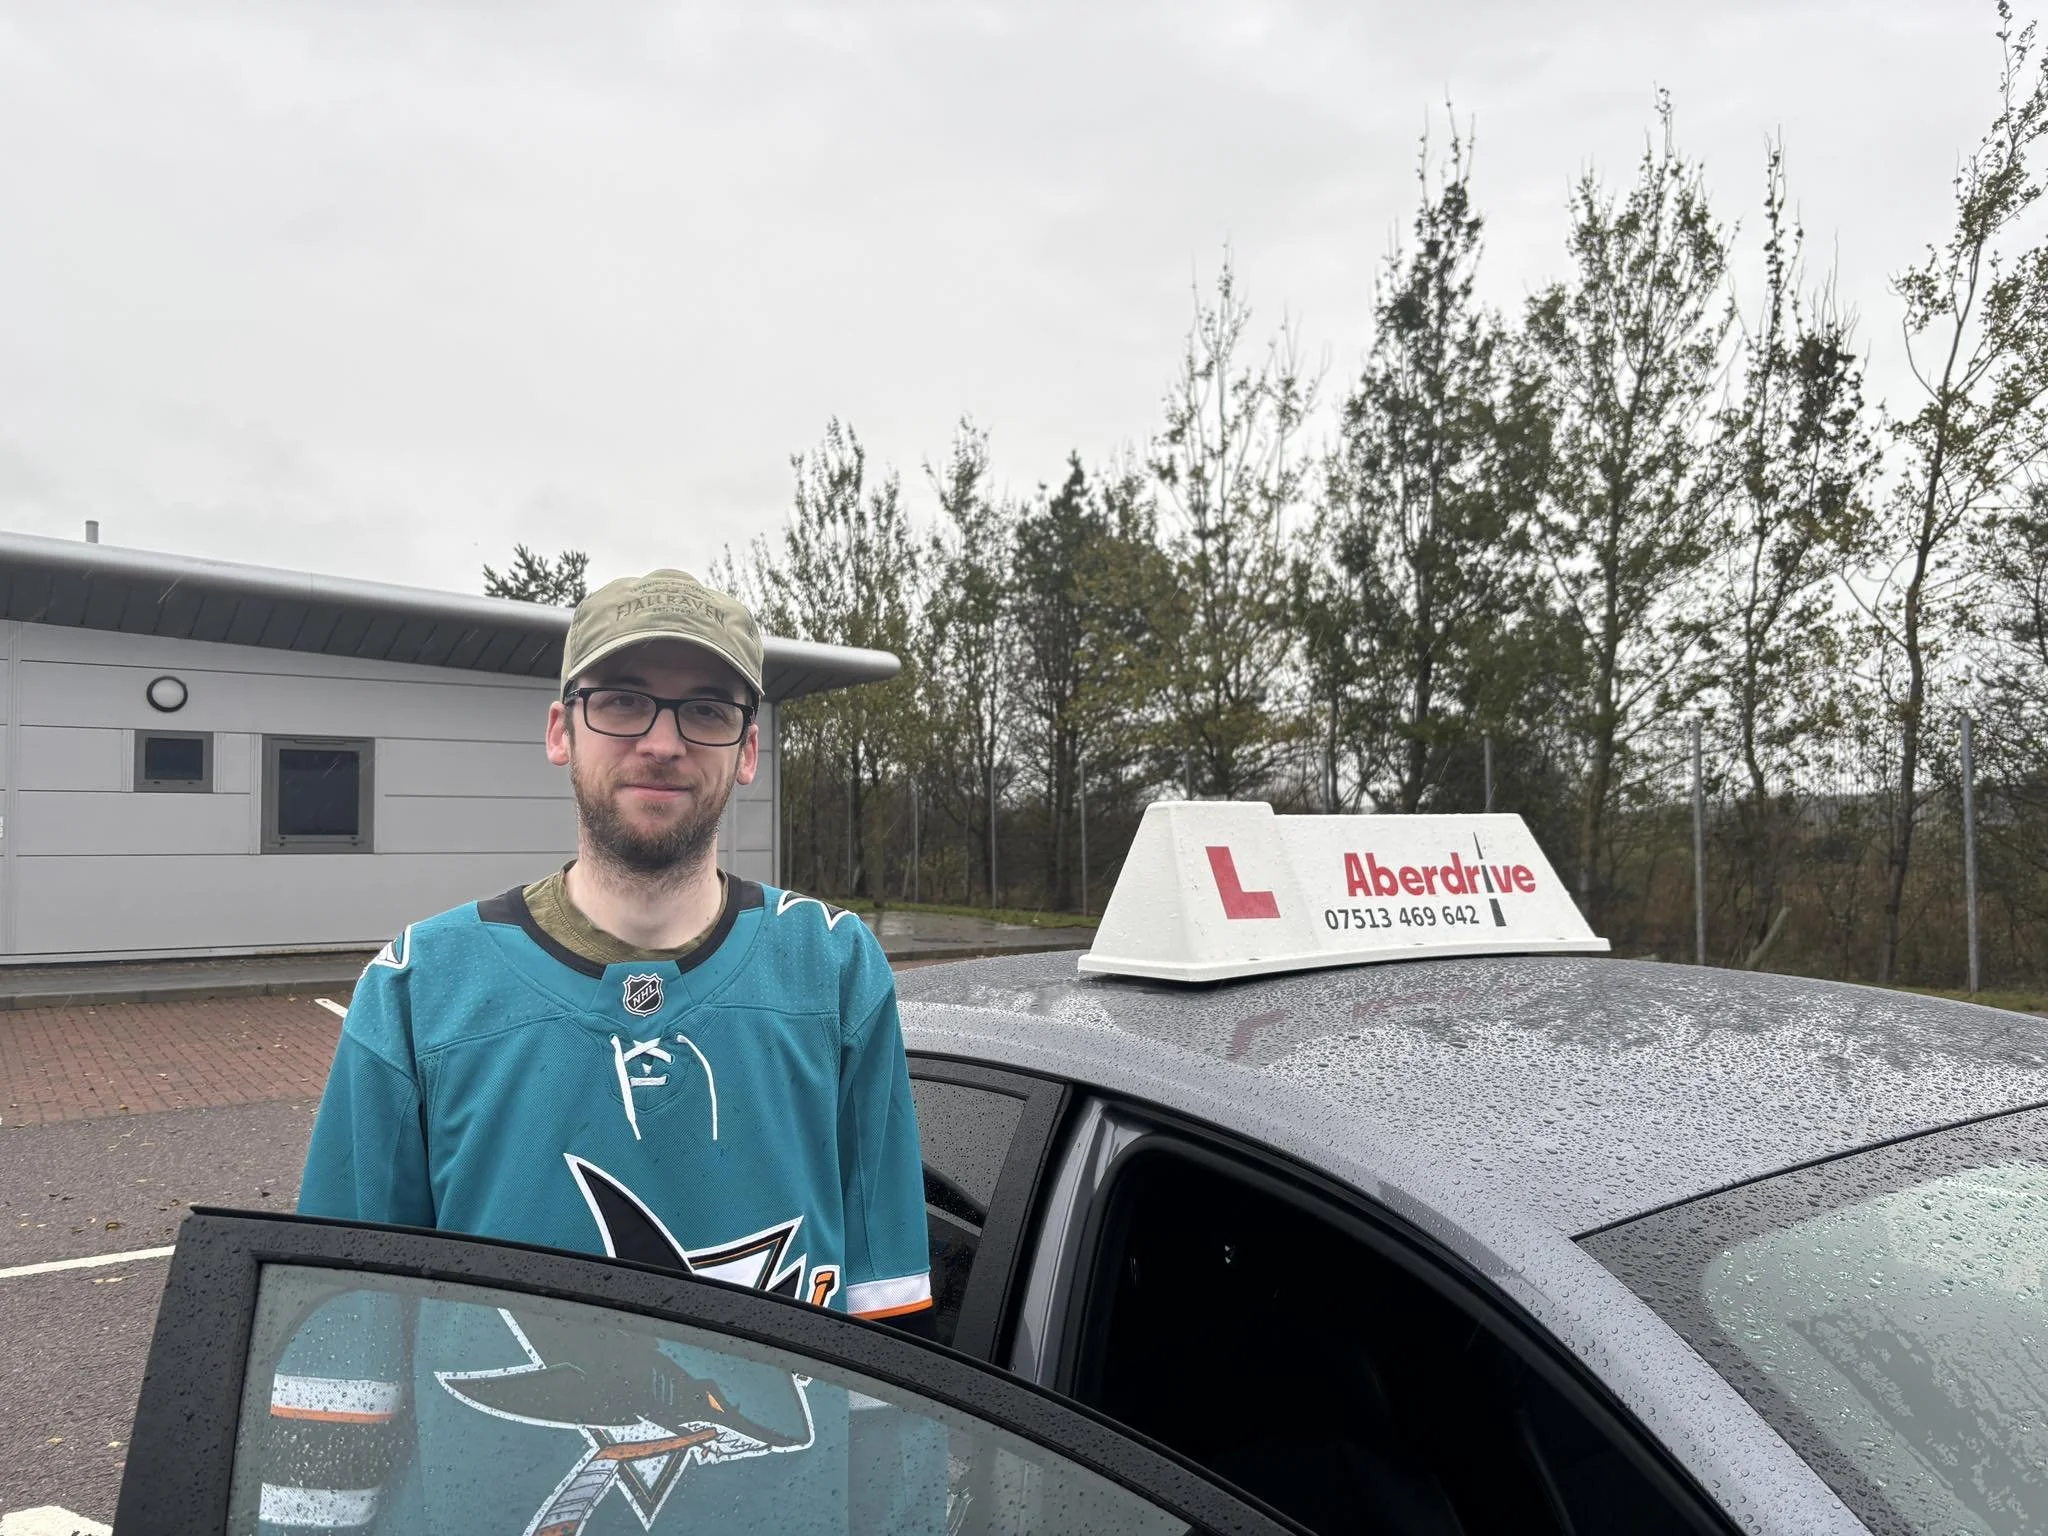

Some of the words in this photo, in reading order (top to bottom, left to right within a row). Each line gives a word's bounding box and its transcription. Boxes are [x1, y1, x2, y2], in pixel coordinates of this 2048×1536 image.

[1204, 845, 1281, 920] L
[1344, 851, 1536, 897] Aberdrive
[1324, 907, 1392, 930] 07513
[1399, 906, 1437, 927] 469
[1442, 904, 1480, 925] 642
[633, 985, 656, 1007] NHL
